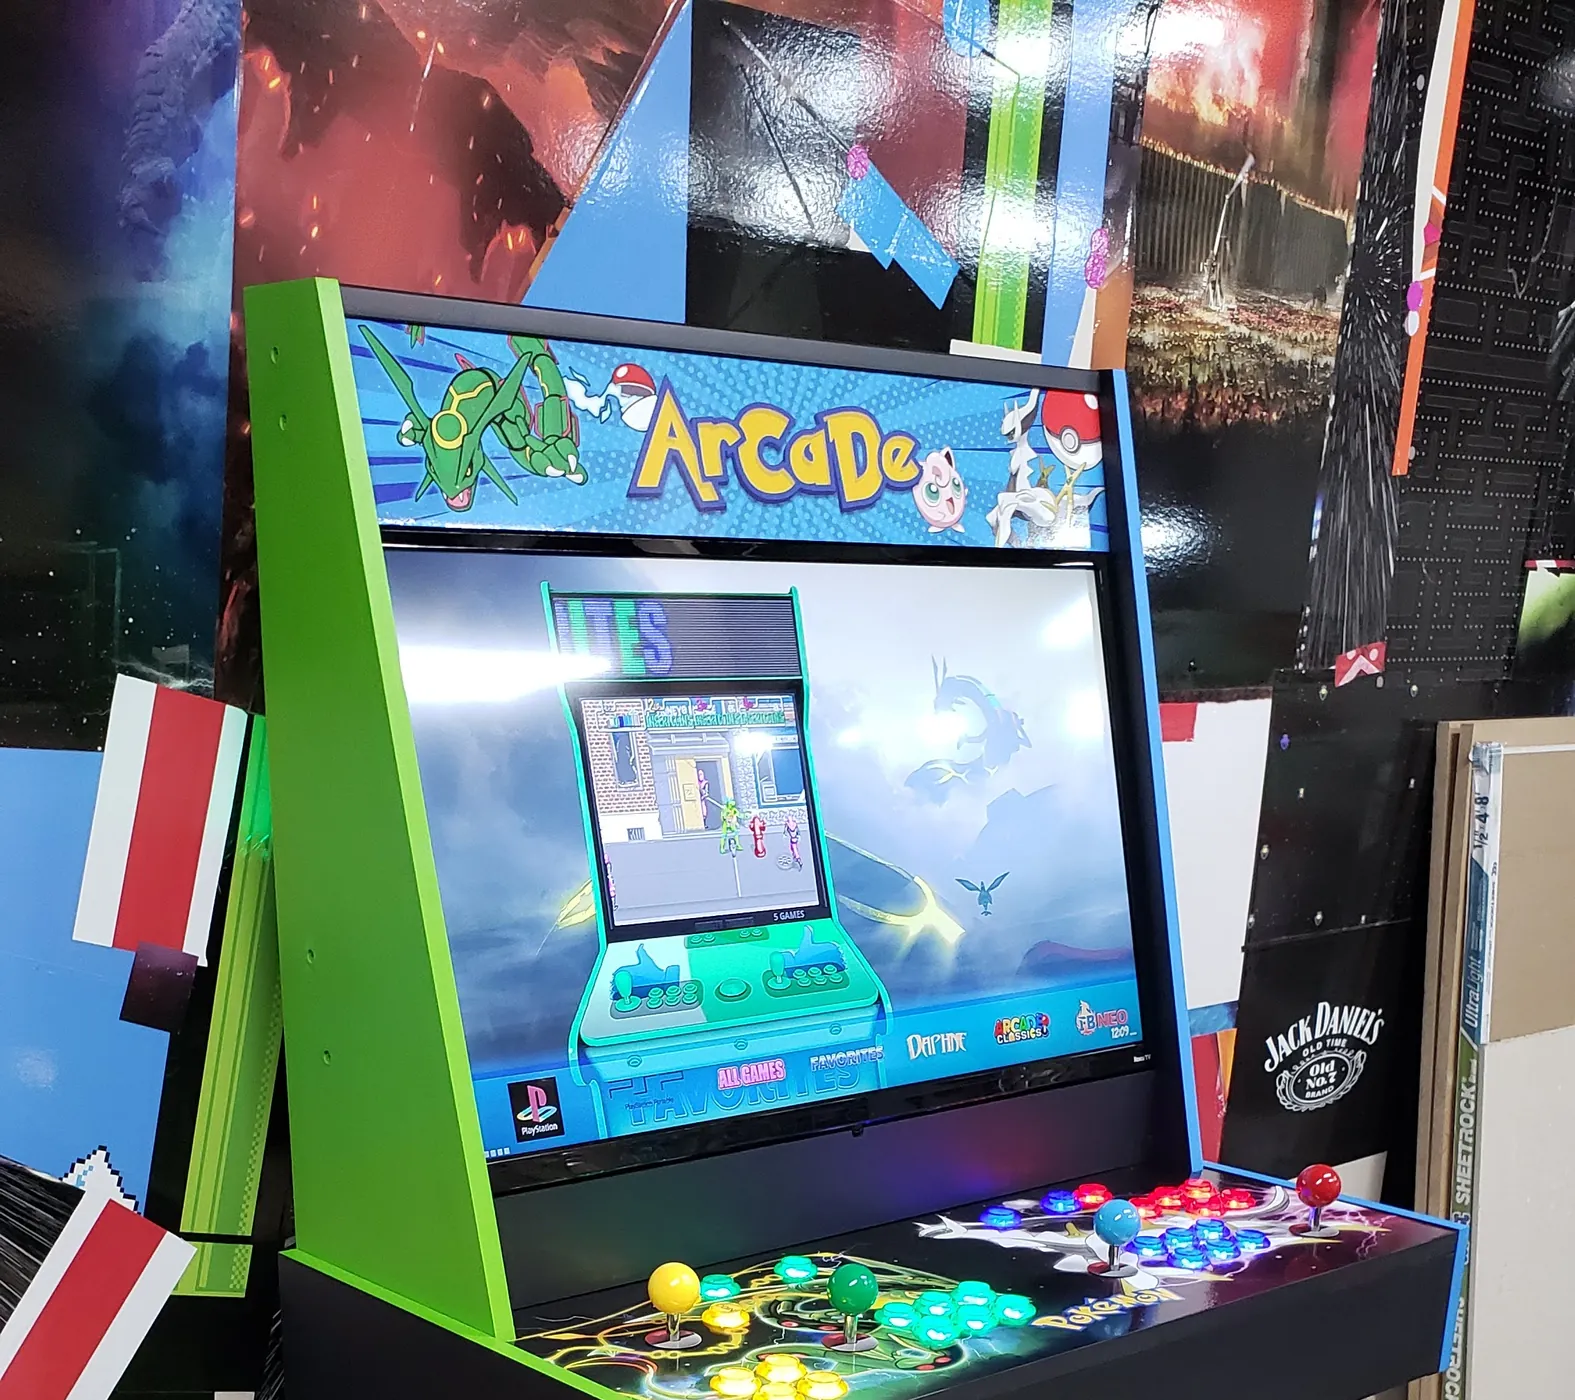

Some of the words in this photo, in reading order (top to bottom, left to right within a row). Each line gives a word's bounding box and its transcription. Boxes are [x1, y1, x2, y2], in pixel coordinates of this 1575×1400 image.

[773, 913, 779, 921] 5
[780, 909, 805, 921] GAMES
[1464, 956, 1482, 1027] UltraLight
[1264, 1015, 1313, 1072] JACK
[1314, 1001, 1385, 1045] DANIEL'S
[1302, 1041, 1323, 1057] OLD
[1326, 1037, 1347, 1048] TIME
[810, 1046, 884, 1072] FAVORITES
[1309, 1060, 1335, 1077] Old
[718, 1067, 741, 1089] ALL
[742, 1059, 785, 1085] GAMES
[1305, 1085, 1335, 1099] BRAND
[521, 1121, 559, 1136] PlayStation
[1455, 1082, 1477, 1205] SHEETROCK
